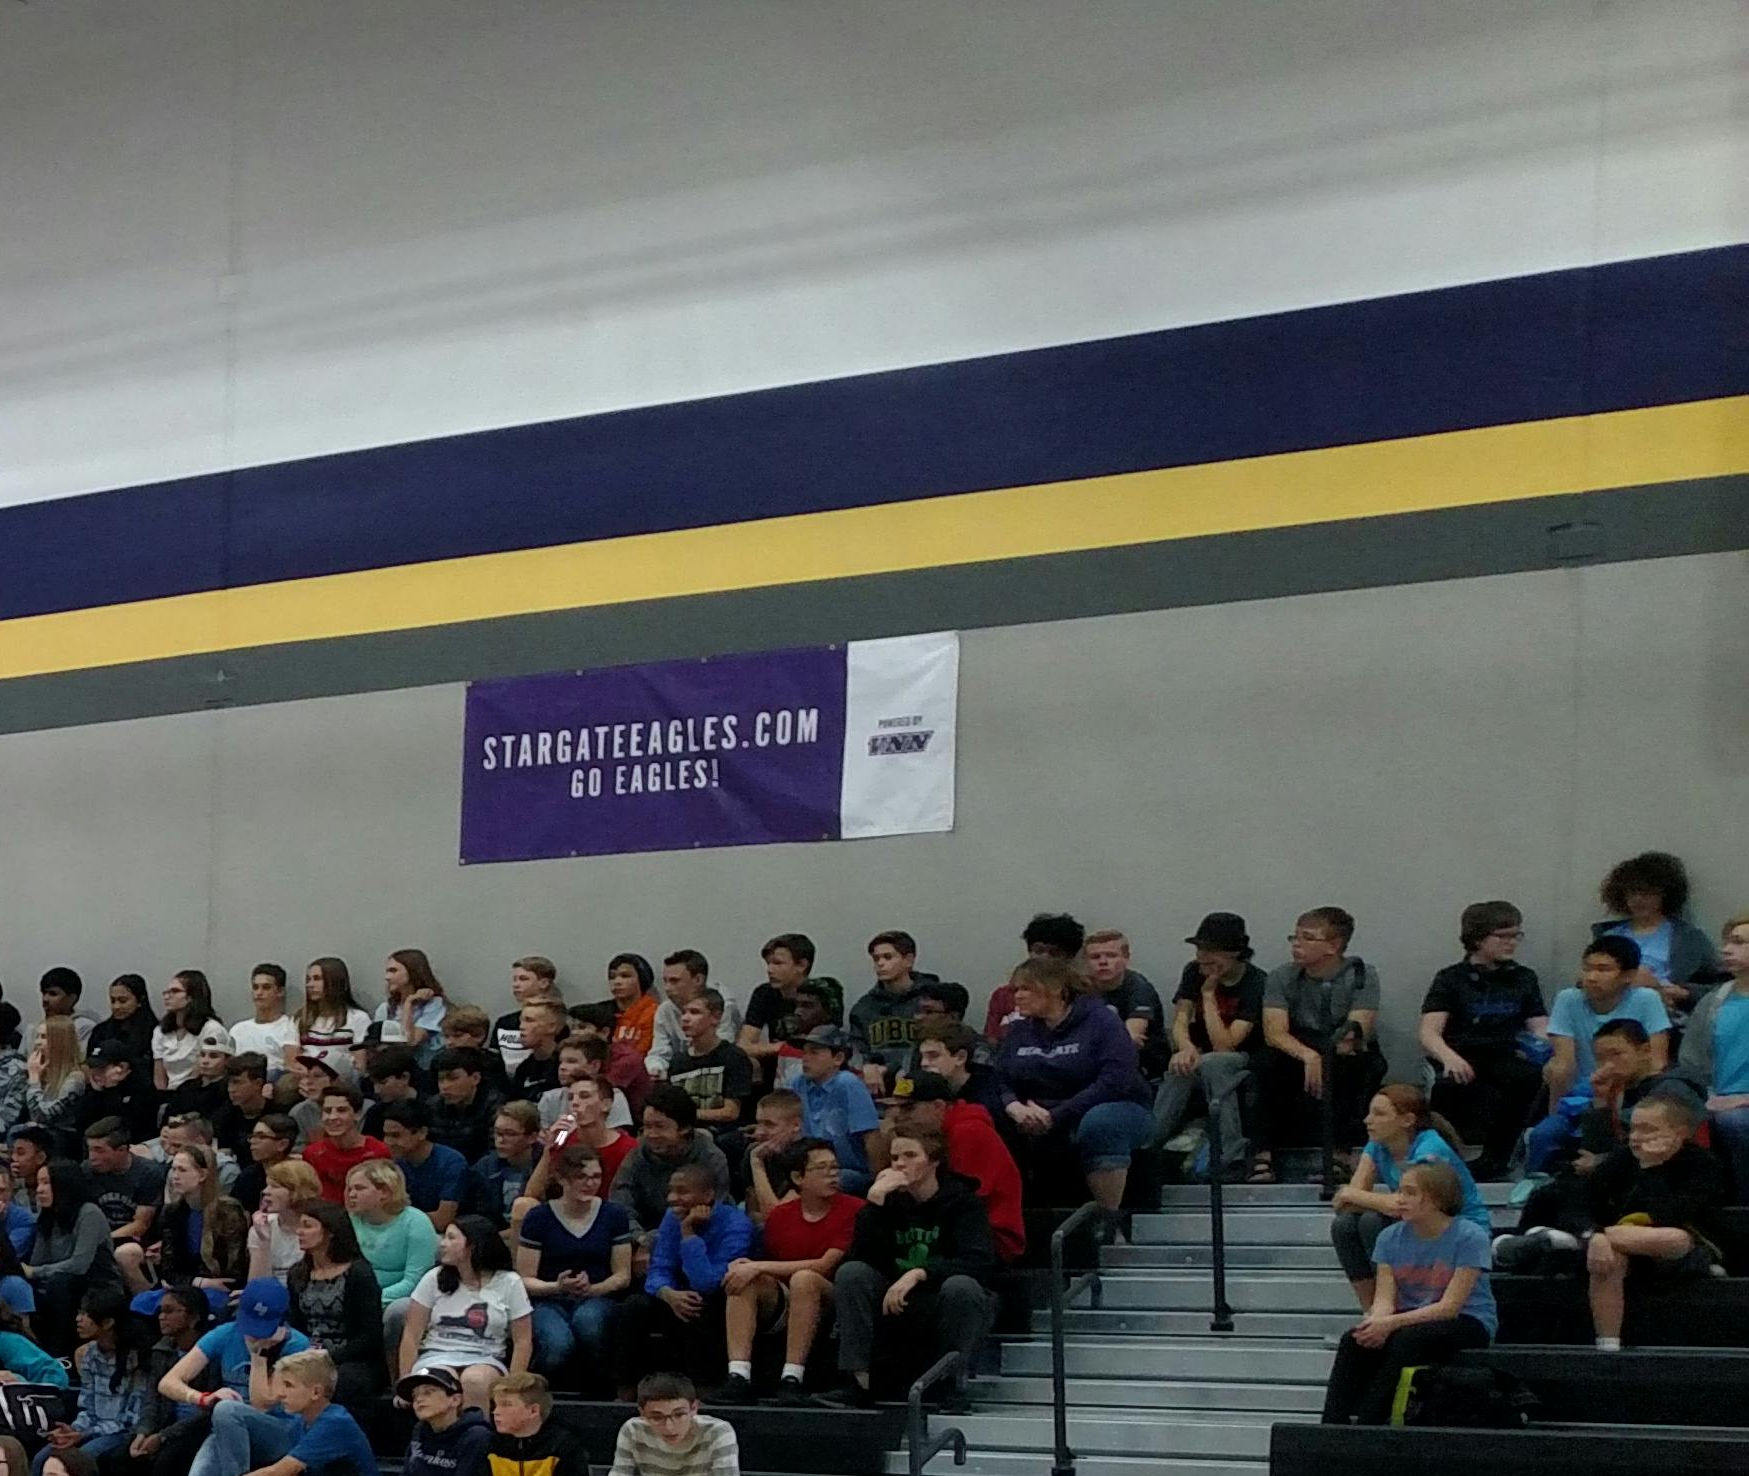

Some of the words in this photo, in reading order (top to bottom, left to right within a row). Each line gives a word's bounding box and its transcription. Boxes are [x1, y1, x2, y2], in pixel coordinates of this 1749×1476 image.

[483, 708, 819, 770] STARGATEEAGLES.COM
[571, 767, 602, 798] GO
[615, 758, 720, 794] EAGLES!
